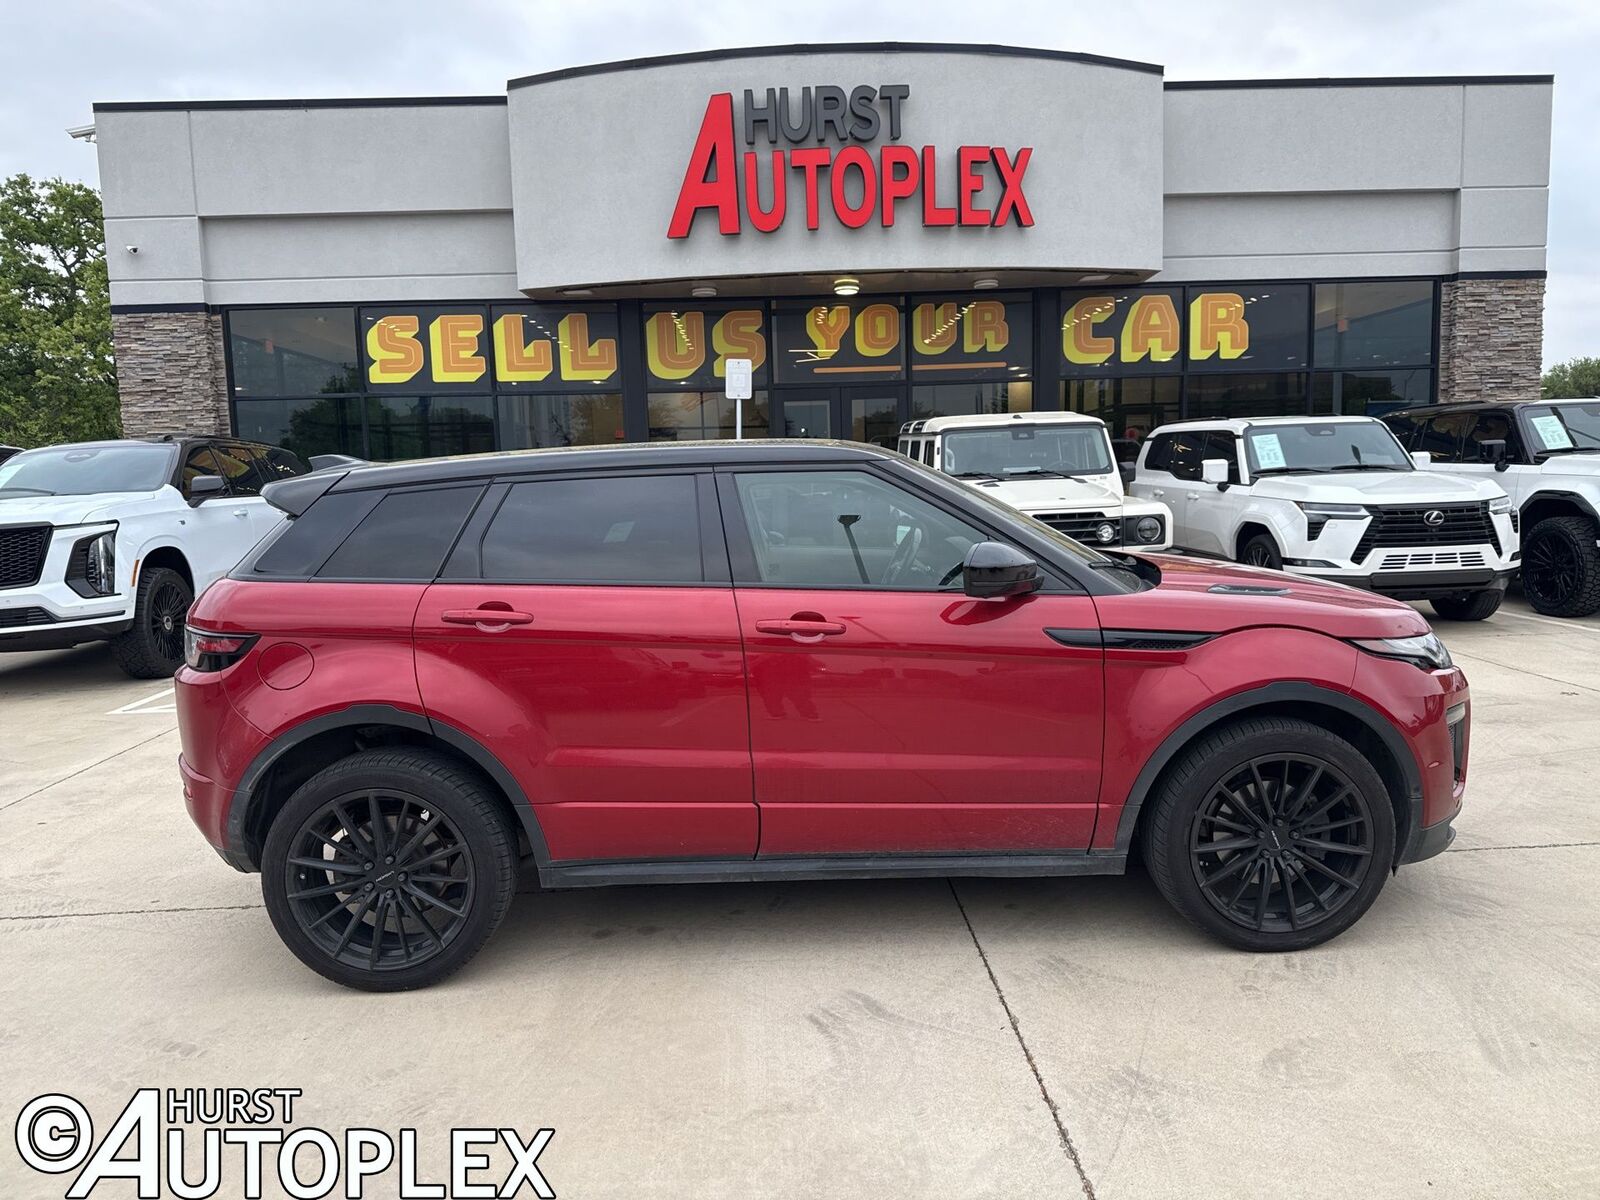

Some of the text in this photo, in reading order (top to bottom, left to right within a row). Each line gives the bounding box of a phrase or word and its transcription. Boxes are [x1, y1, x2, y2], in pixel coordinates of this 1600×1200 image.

[744, 85, 910, 145] HURST
[667, 92, 1034, 239] AUTOPLEX
[366, 313, 618, 384] SELL
[646, 309, 766, 380] US
[806, 300, 1009, 360] YOUR
[1062, 292, 1249, 365] CAR
